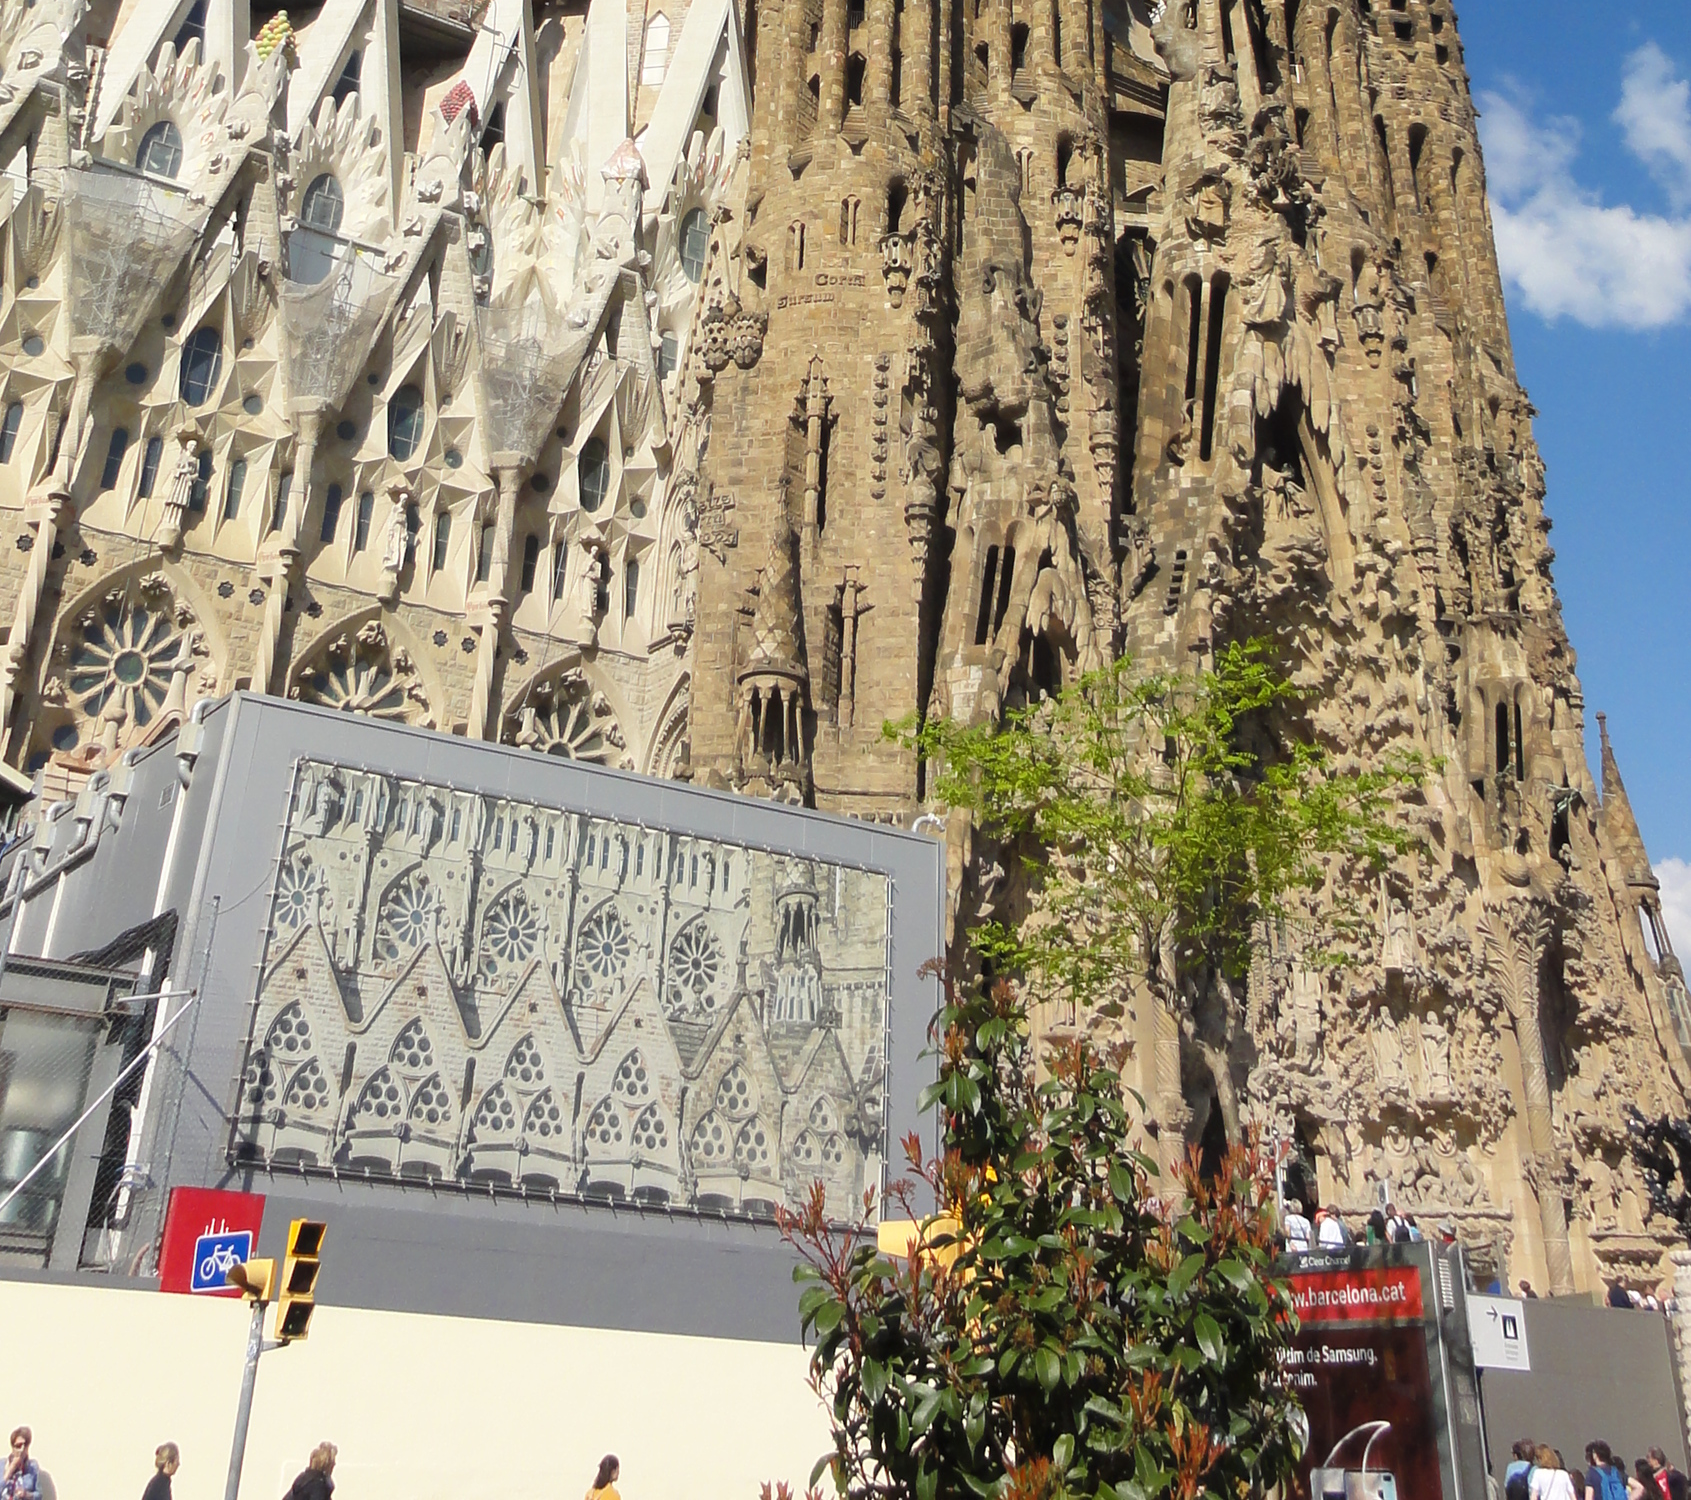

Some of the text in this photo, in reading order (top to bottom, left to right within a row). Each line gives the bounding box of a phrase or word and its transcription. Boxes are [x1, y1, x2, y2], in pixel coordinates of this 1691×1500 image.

[1290, 1280, 1407, 1309] w.barcelona.cat
[1306, 1347, 1320, 1363] de
[1321, 1345, 1378, 1366] Samsung.
